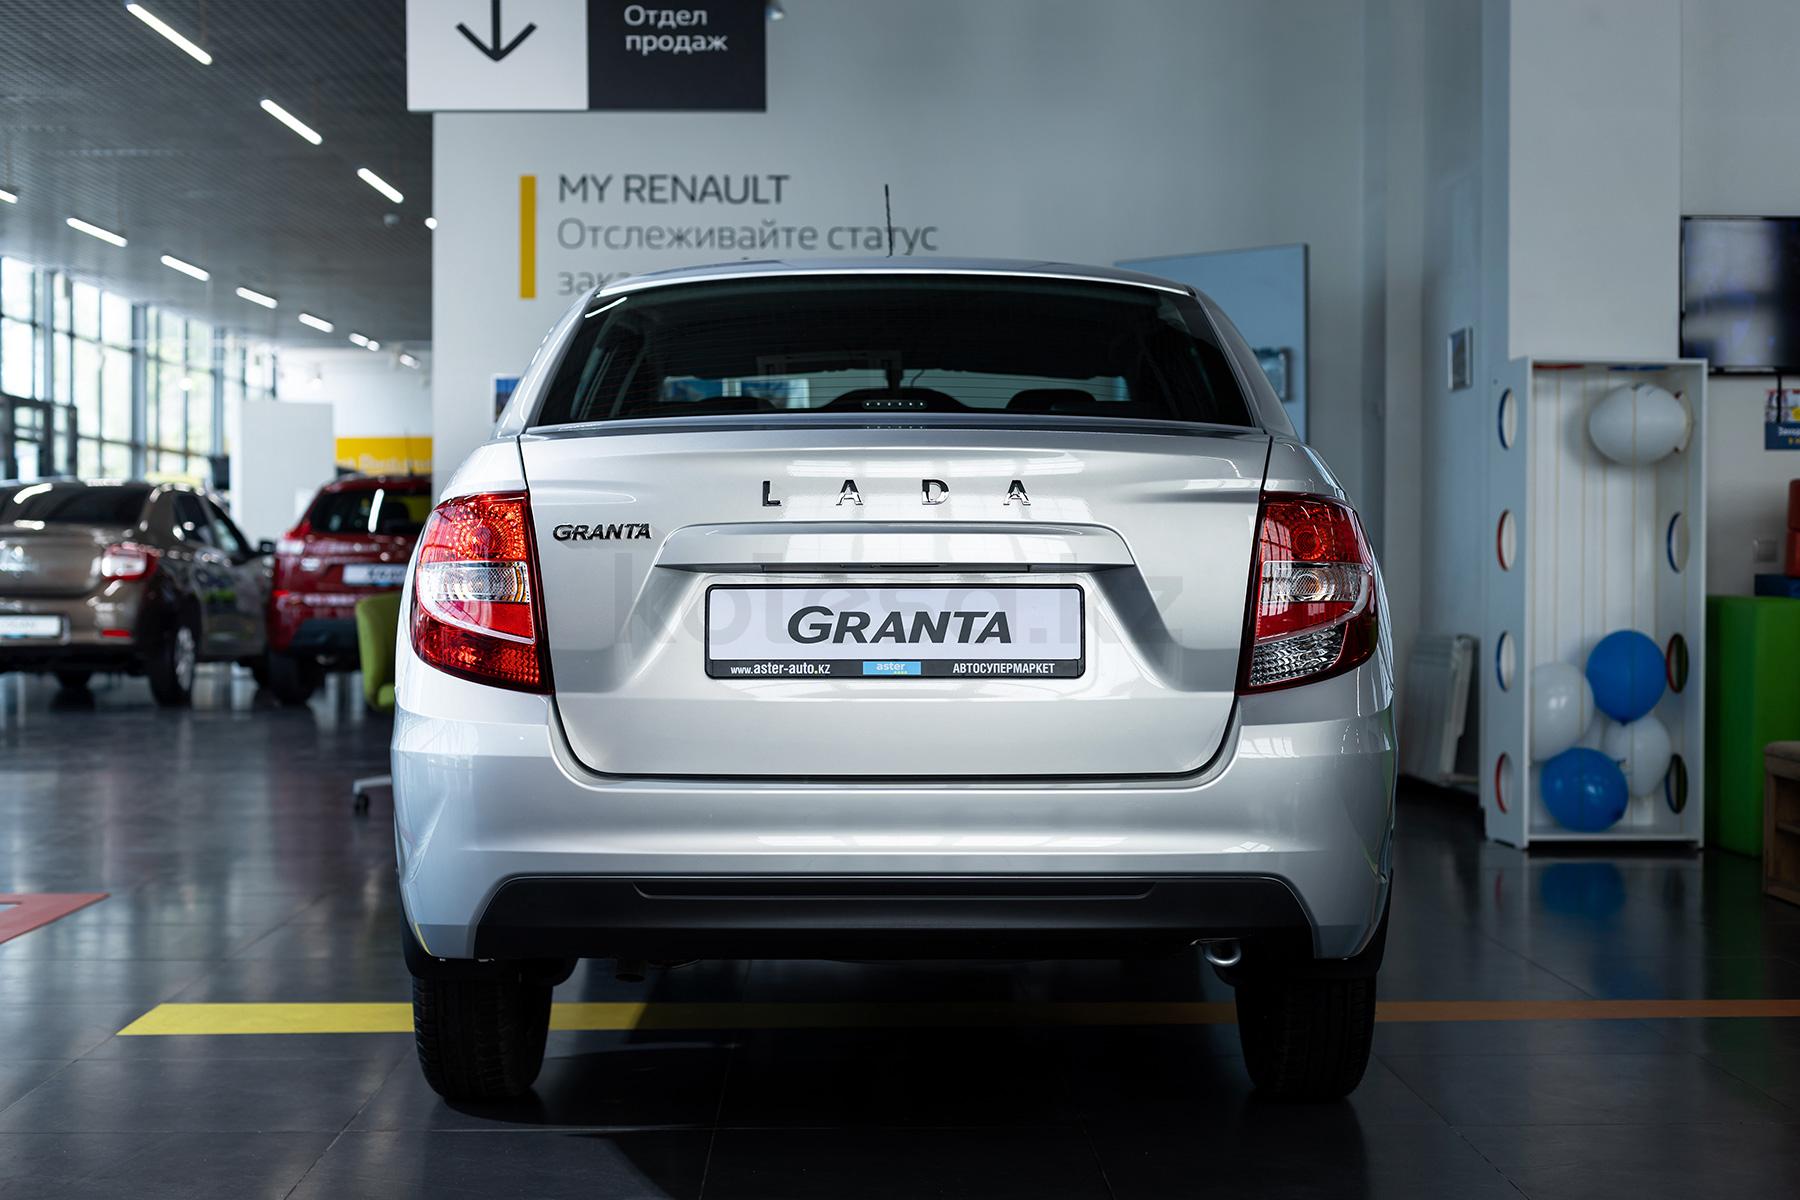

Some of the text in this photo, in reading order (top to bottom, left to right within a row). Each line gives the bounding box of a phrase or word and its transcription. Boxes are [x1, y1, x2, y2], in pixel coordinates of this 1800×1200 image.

[624, 4, 708, 29] Отдел
[625, 34, 728, 56] продаж
[559, 173, 790, 204] MY RENAULT
[557, 217, 938, 256] Отслеживайте статус
[762, 479, 1031, 507] LADA
[552, 523, 651, 541] GRANTA
[787, 606, 1012, 645] GRANTA
[876, 662, 906, 671] aster
[952, 662, 1056, 674] АВТОСУПЕРМАРКЕТ
